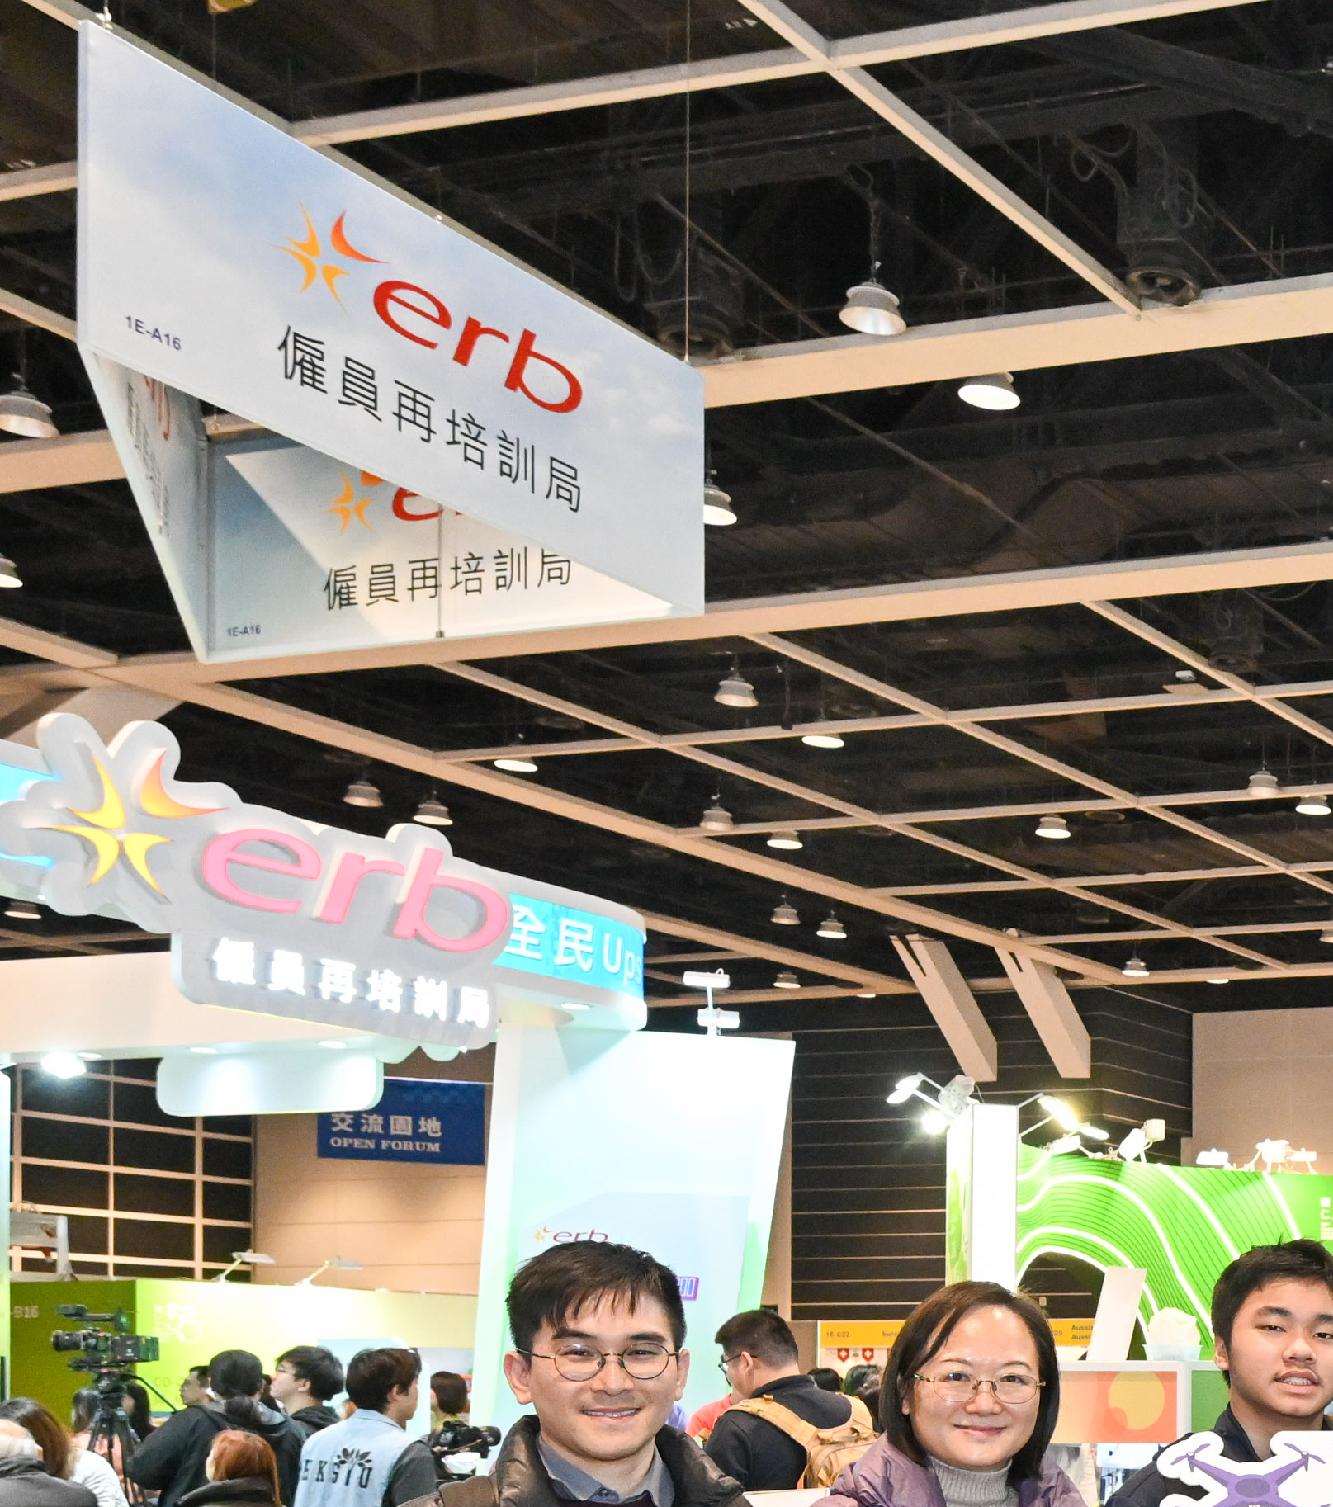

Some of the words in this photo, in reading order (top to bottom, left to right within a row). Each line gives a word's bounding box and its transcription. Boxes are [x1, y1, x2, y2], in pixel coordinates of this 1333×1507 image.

[124, 315, 182, 351] 1E-A16
[373, 279, 583, 414] erb
[277, 325, 583, 514] 僱員再培訓局
[324, 546, 571, 611] 僱員再培訓局
[201, 828, 512, 953] erb
[330, 1137, 375, 1148] OPEN
[381, 1140, 440, 1152] FORUM
